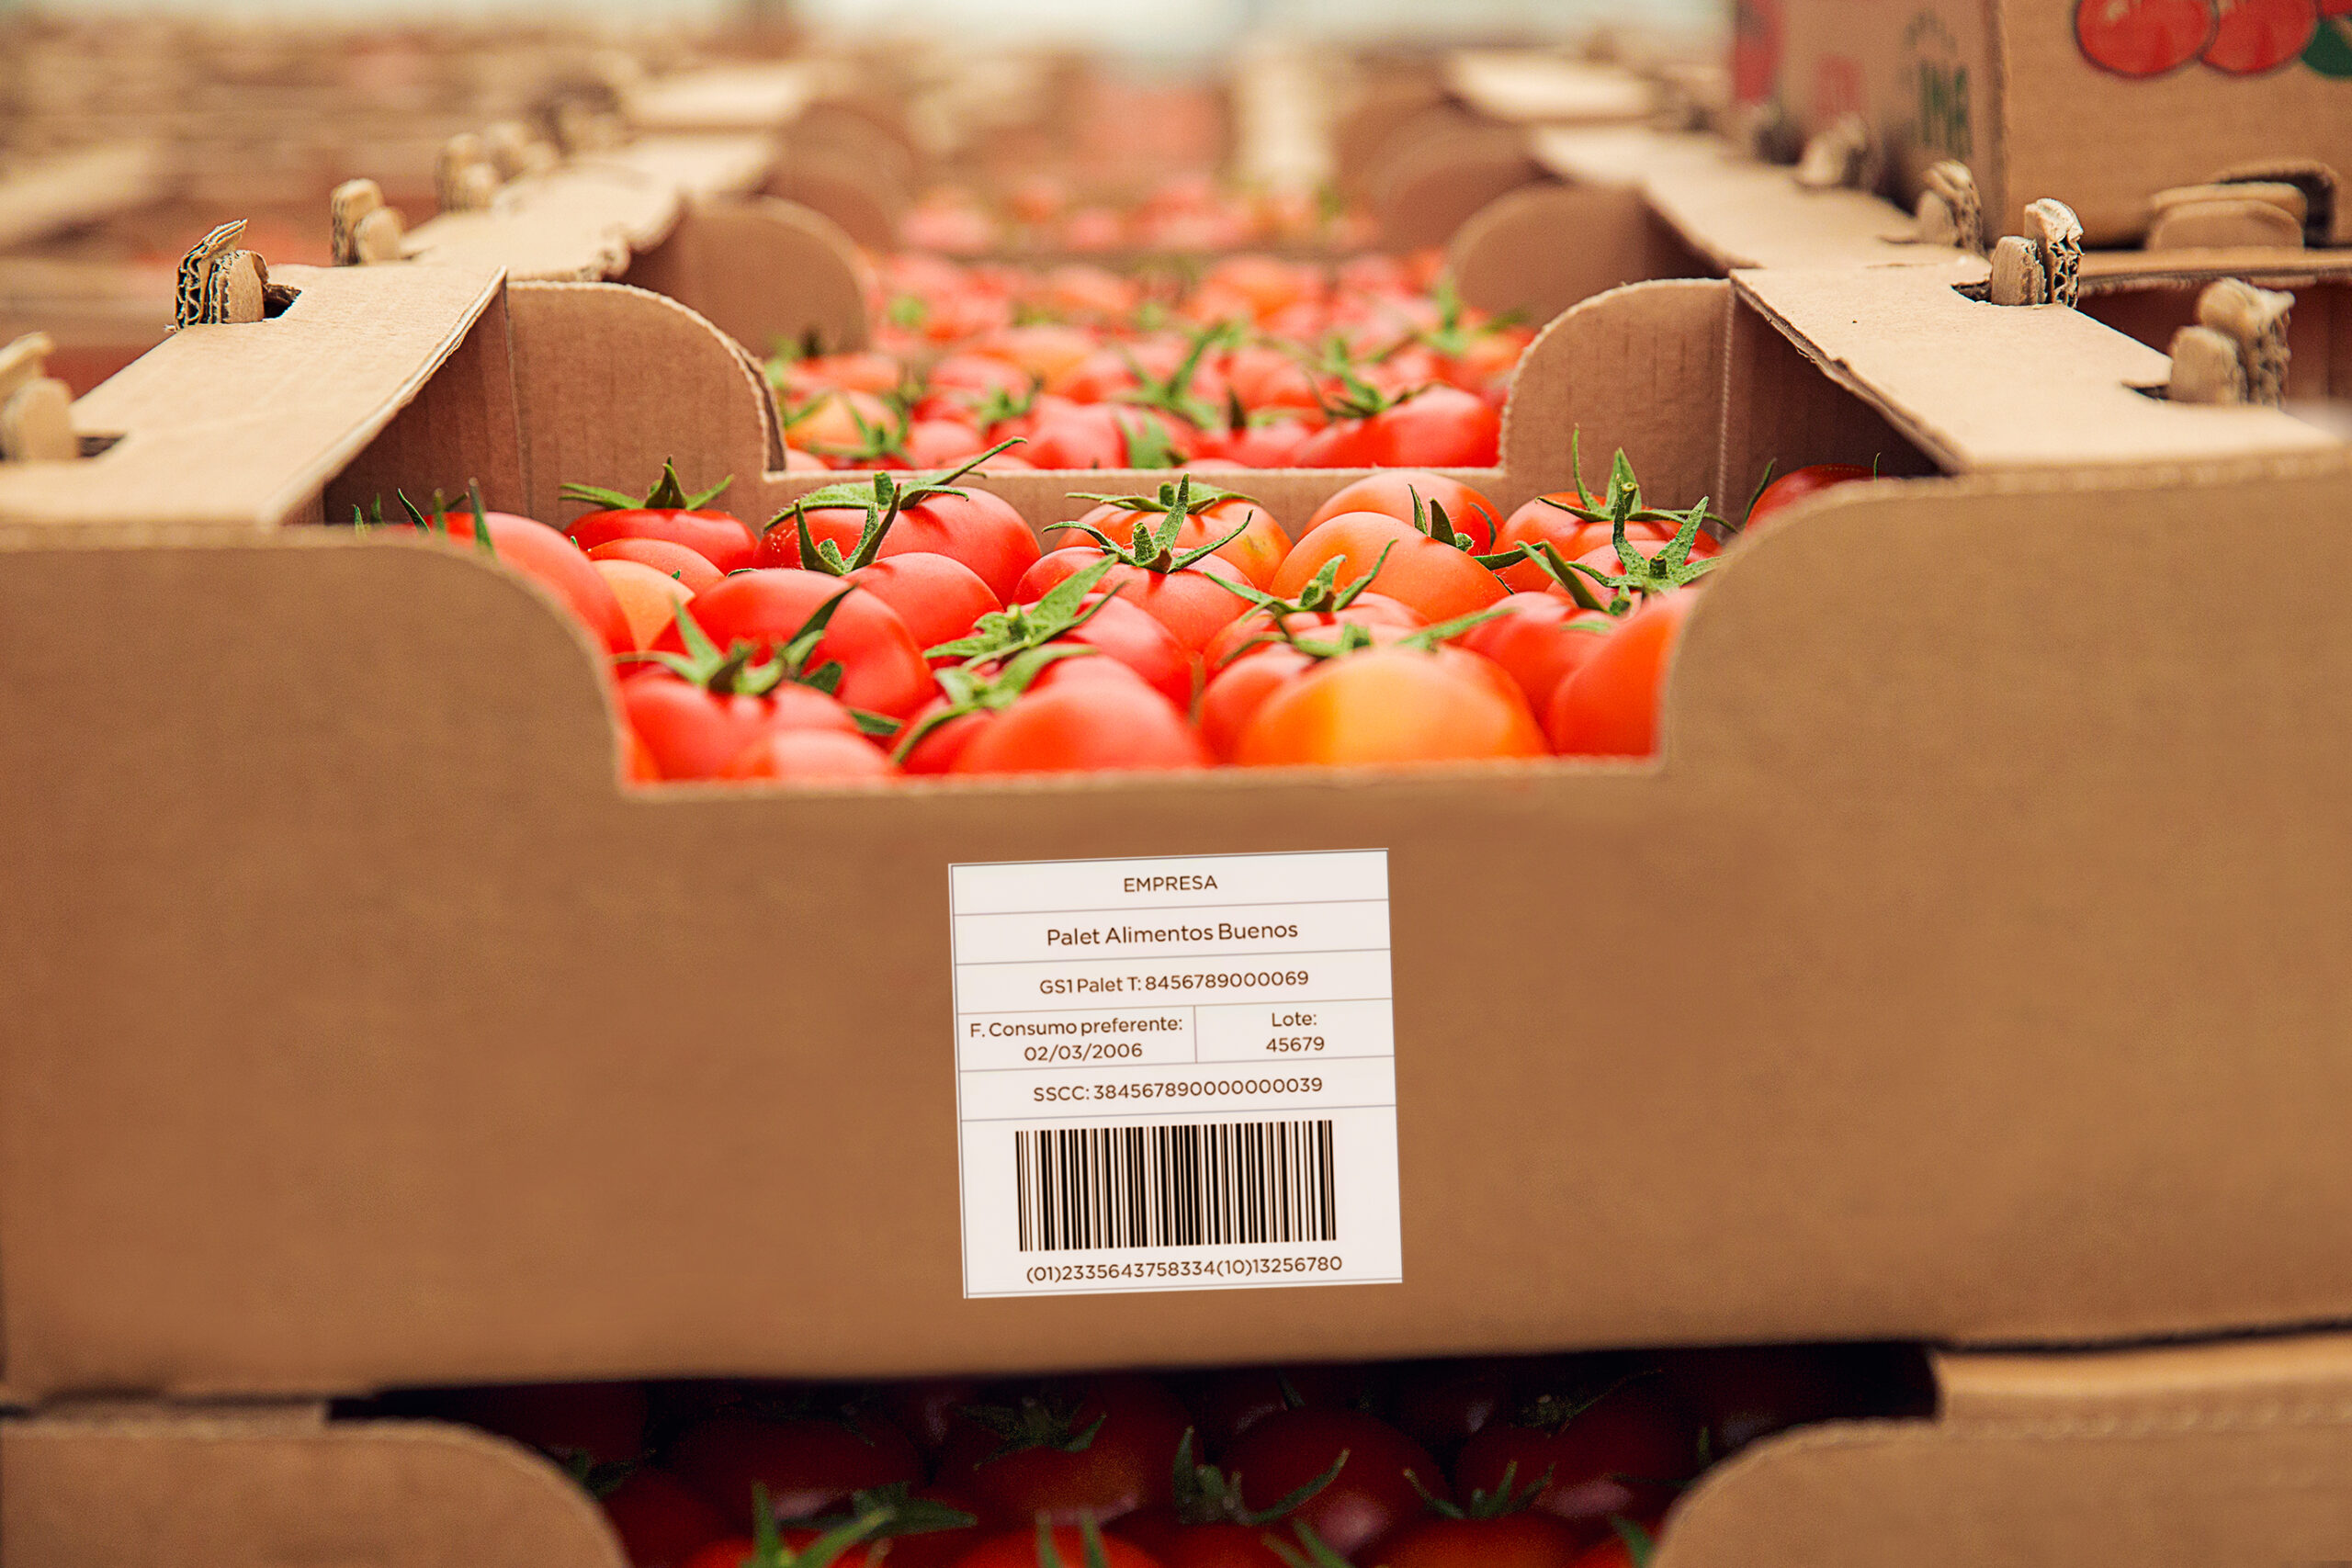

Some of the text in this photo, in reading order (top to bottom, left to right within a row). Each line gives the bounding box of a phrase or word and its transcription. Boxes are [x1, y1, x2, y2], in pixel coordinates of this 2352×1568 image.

[1124, 874, 1218, 893] EMPRESA
[1047, 922, 1299, 946] Palet Alimentos Buenos
[1039, 970, 1309, 995] GS1 Palet T: 8456789000069
[970, 1016, 1183, 1038] F. Consumo preferente:
[1272, 1011, 1317, 1028] Lote:
[1023, 1043, 1143, 1063] 02/03/2006
[1265, 1036, 1325, 1053] 45679
[1034, 1077, 1323, 1102] SSCC: 384567890000000039
[1026, 1256, 1343, 1284] (01)2335643758334(10)13256780
